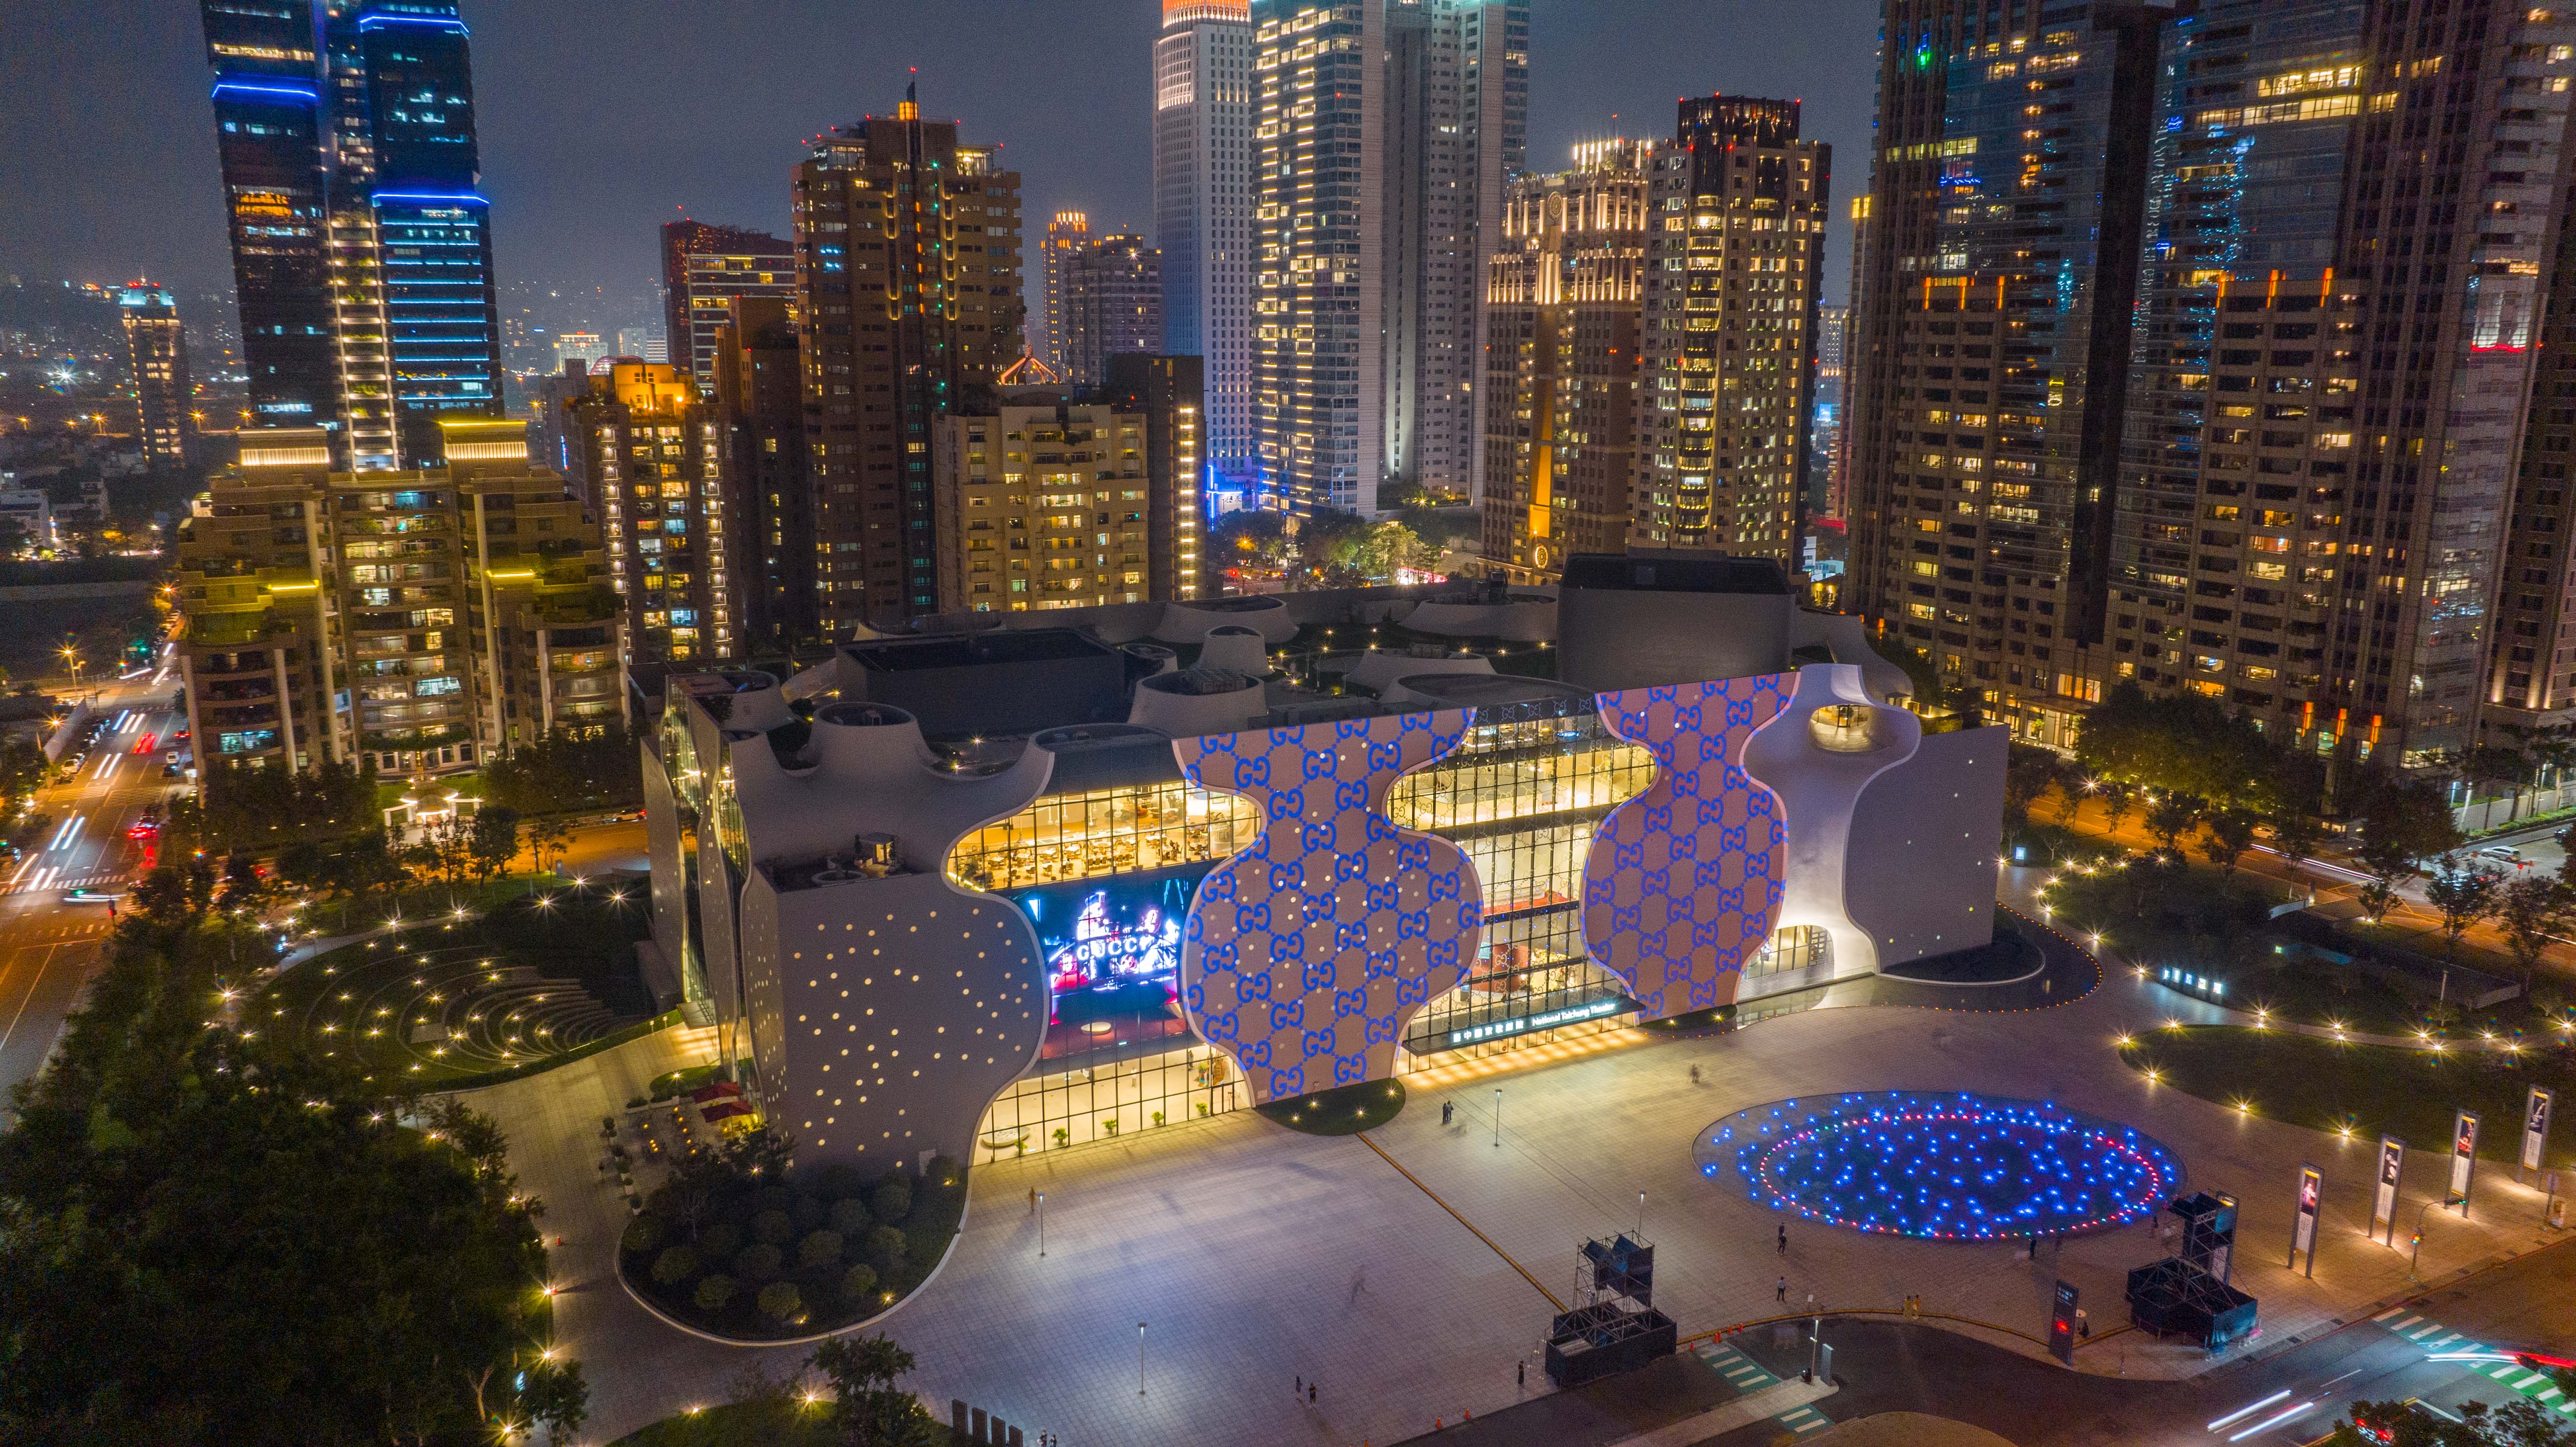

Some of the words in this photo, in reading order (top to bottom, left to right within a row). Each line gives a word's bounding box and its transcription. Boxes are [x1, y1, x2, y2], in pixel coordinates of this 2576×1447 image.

[1077, 936, 1146, 960] GUCCI
[1532, 1013, 1561, 1026] National
[1561, 1009, 1590, 1020] Taichung
